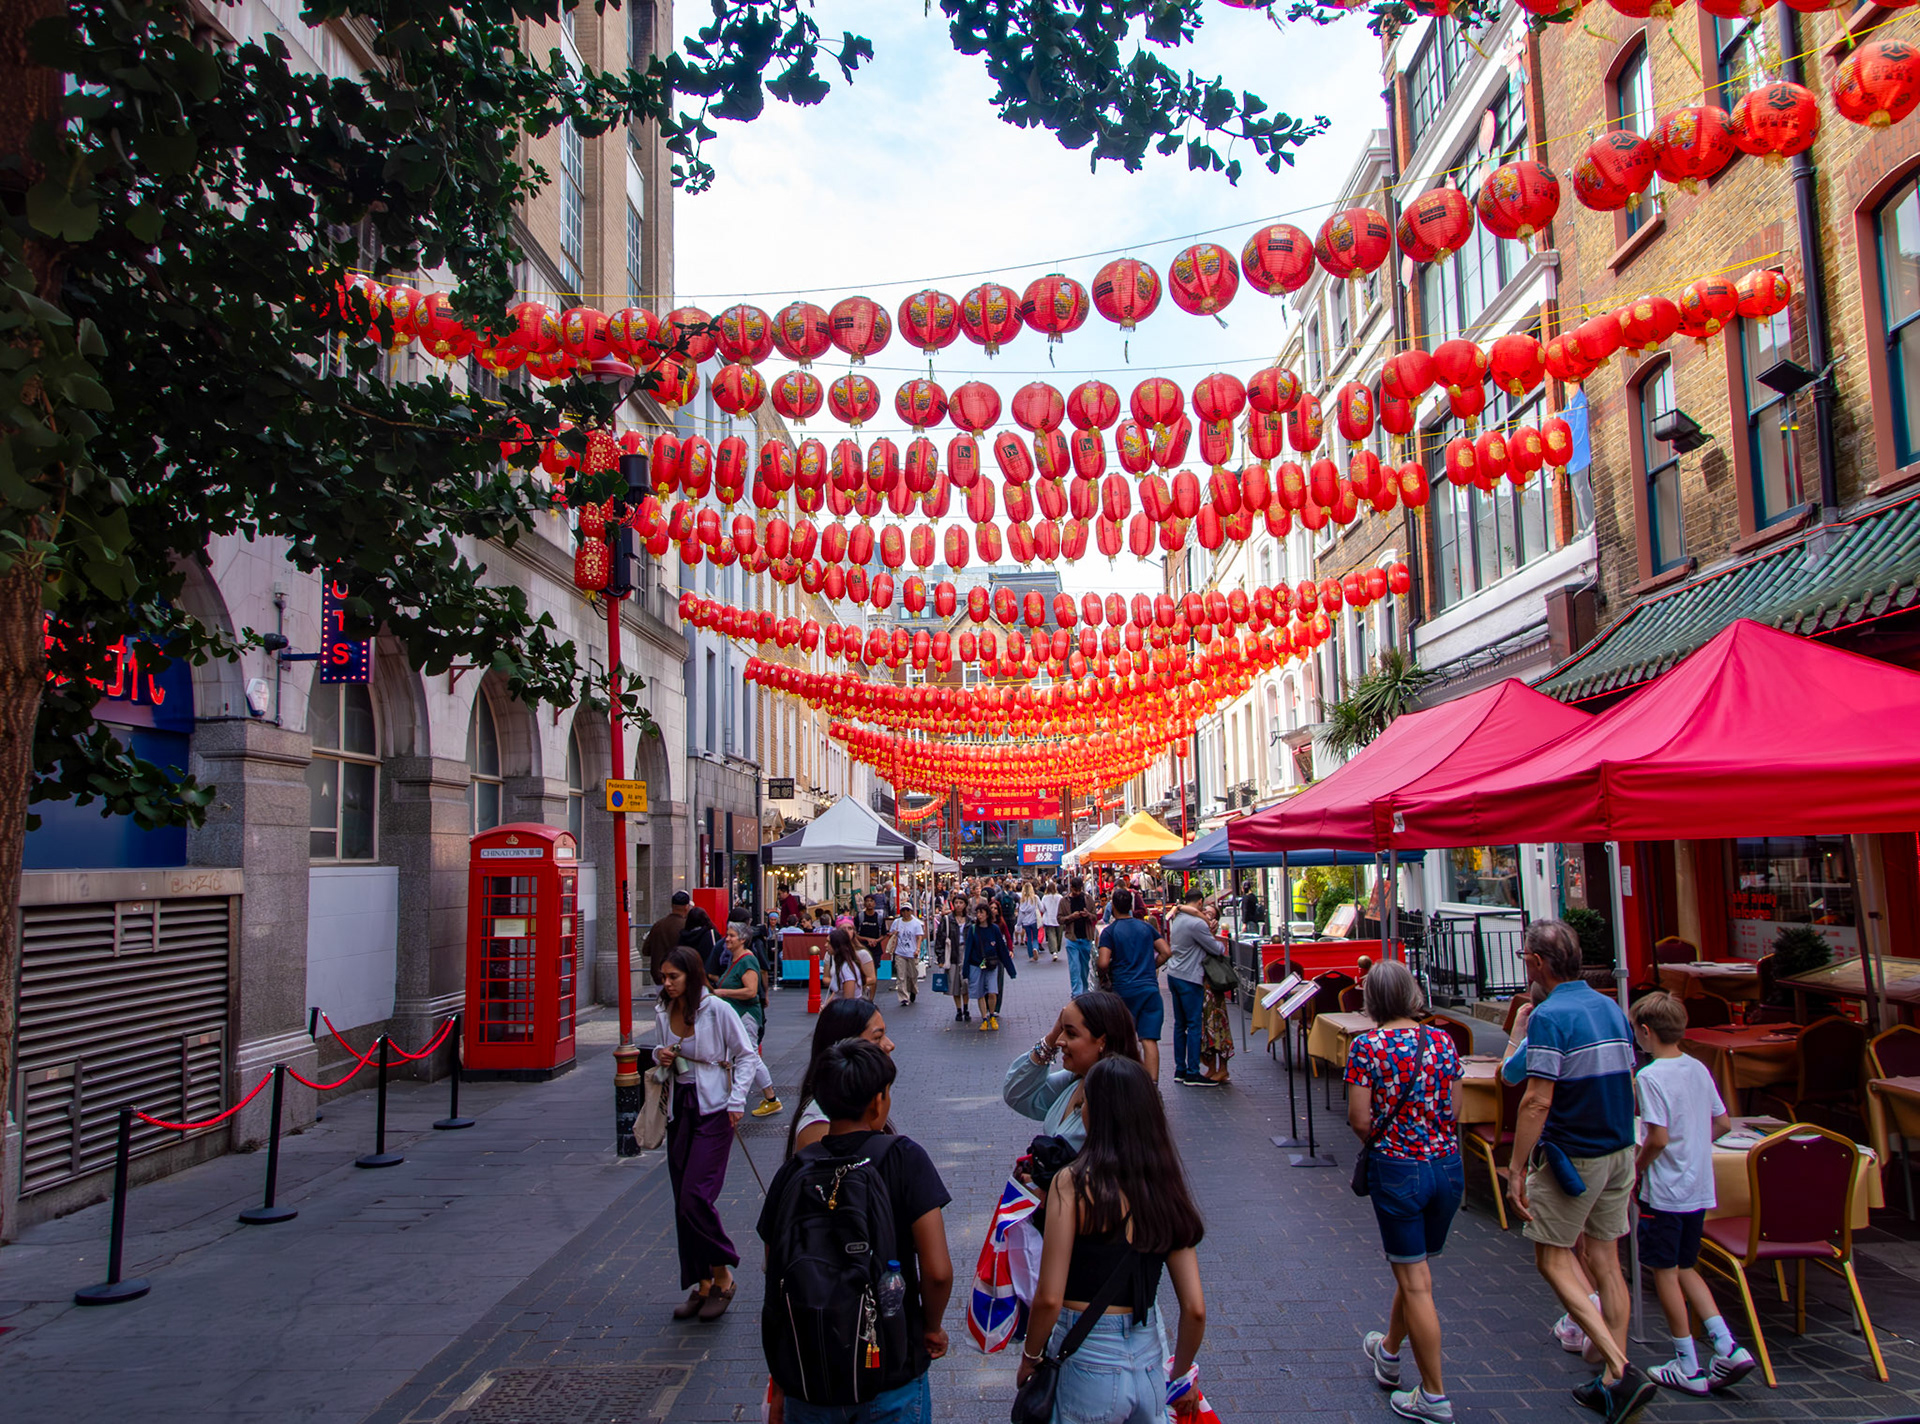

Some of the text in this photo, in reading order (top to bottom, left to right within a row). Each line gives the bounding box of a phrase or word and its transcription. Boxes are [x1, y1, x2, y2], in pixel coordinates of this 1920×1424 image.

[1025, 844, 1063, 852] BETFRED
[482, 849, 527, 857] CHINATOWN
[1751, 893, 1777, 908] away
